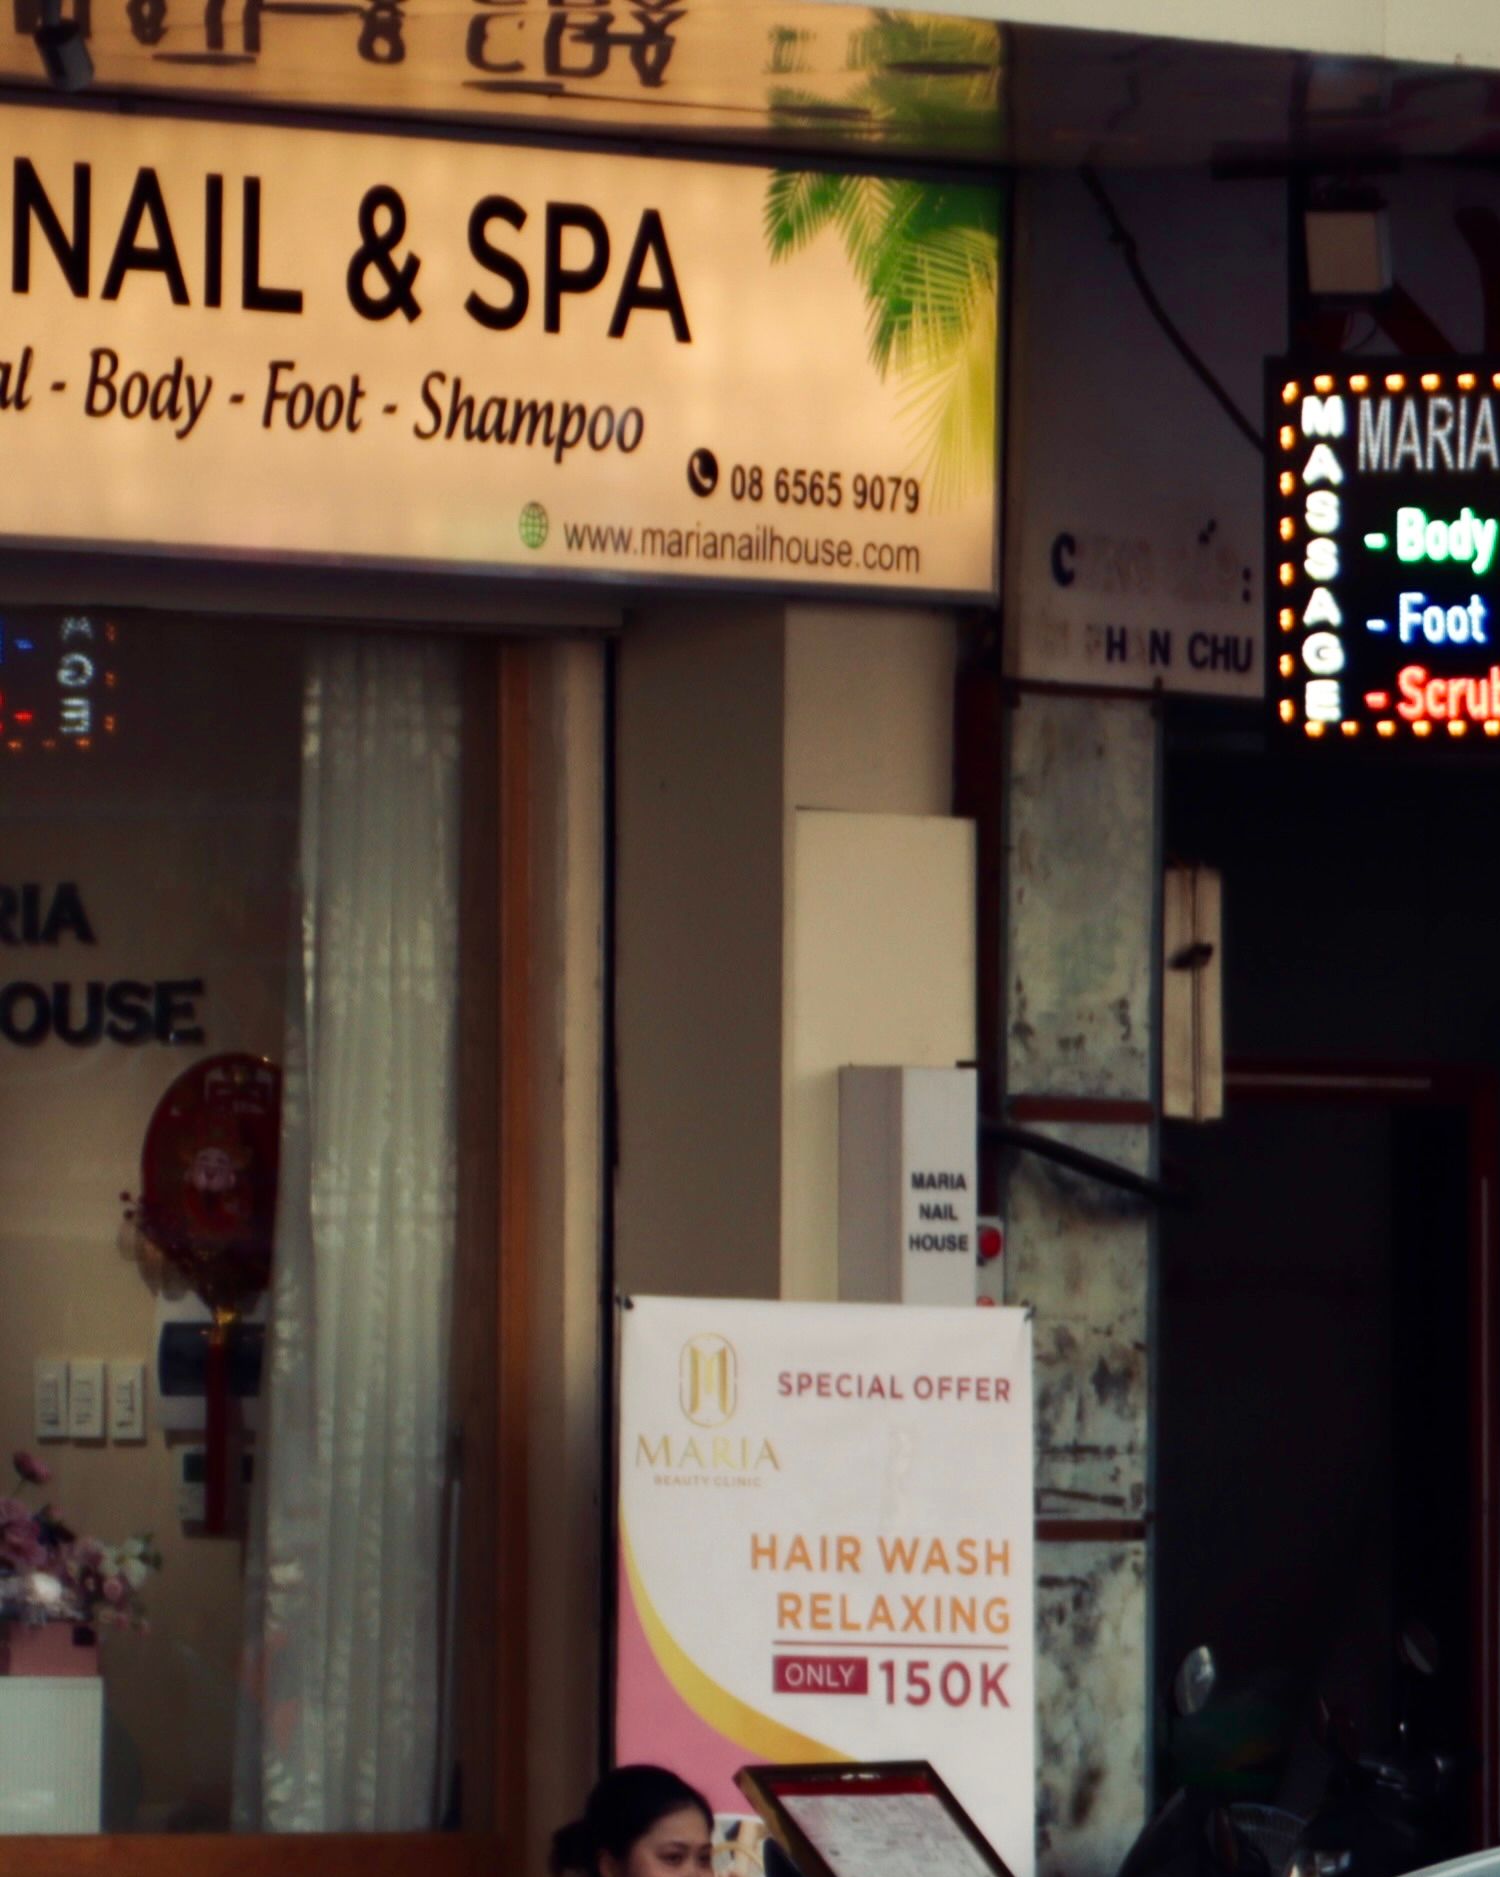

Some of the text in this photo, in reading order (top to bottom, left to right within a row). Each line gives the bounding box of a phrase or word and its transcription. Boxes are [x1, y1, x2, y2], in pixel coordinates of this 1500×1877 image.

[12, 155, 694, 344] NAIL & SPA
[85, 347, 212, 440] Body
[261, 357, 365, 436] Foot
[412, 370, 647, 466] Shampoo
[1357, 394, 1500, 473] MARIA
[730, 464, 921, 515] 08 6565 9079
[563, 521, 921, 573] www.marianailhouse.com
[1395, 506, 1498, 575] Body
[1398, 591, 1489, 645] Foot
[0, 978, 205, 1049] OUSE
[910, 1171, 968, 1193] MARIA
[917, 1202, 960, 1223] NAIL
[907, 1233, 970, 1254] HOUSE
[777, 1369, 1013, 1403] SPECIAL OFFER
[634, 1433, 782, 1473] MARIA
[749, 1532, 1013, 1579] HAIR WASH
[776, 1591, 1013, 1637] RELAXING
[784, 1658, 1013, 1709] ONLY 150K
